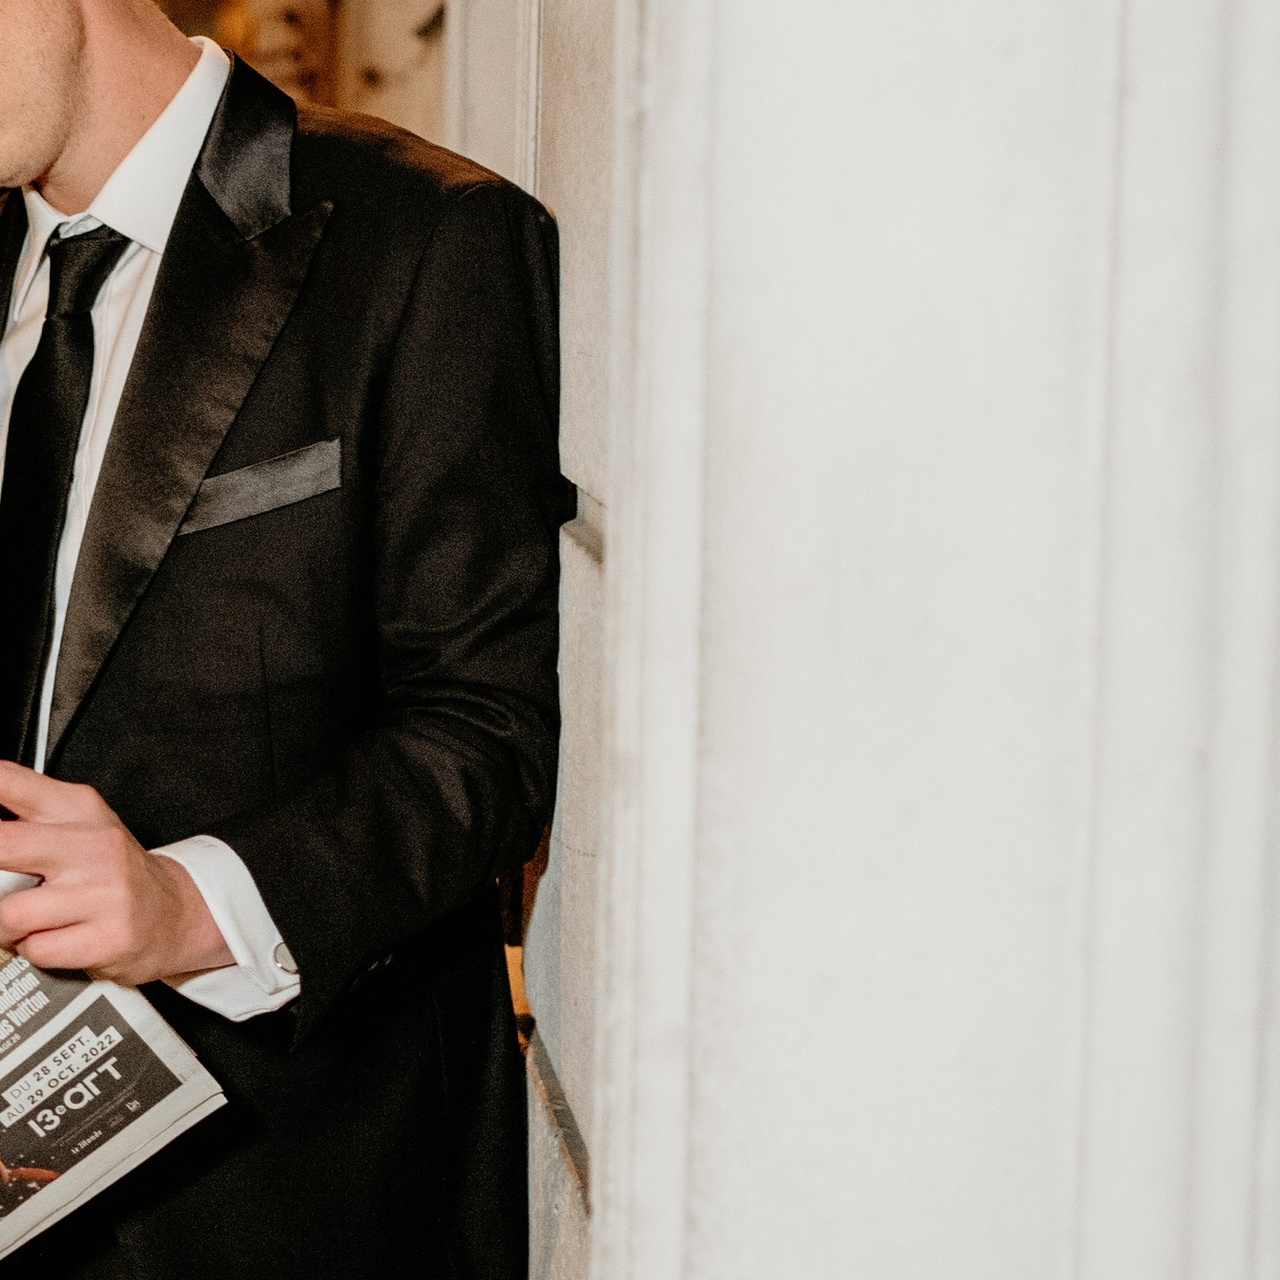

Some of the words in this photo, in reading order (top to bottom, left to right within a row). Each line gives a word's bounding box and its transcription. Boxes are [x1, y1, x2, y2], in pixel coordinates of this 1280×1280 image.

[5, 989, 50, 1026] Vuitton
[4, 1102, 25, 1121] AU
[26, 1087, 45, 1105] 29
[46, 1061, 80, 1089] OCT.
[80, 1032, 115, 1063] 2022
[9, 1079, 31, 1099] DU
[32, 1064, 51, 1082] 28
[52, 1033, 90, 1067] SEPT.
